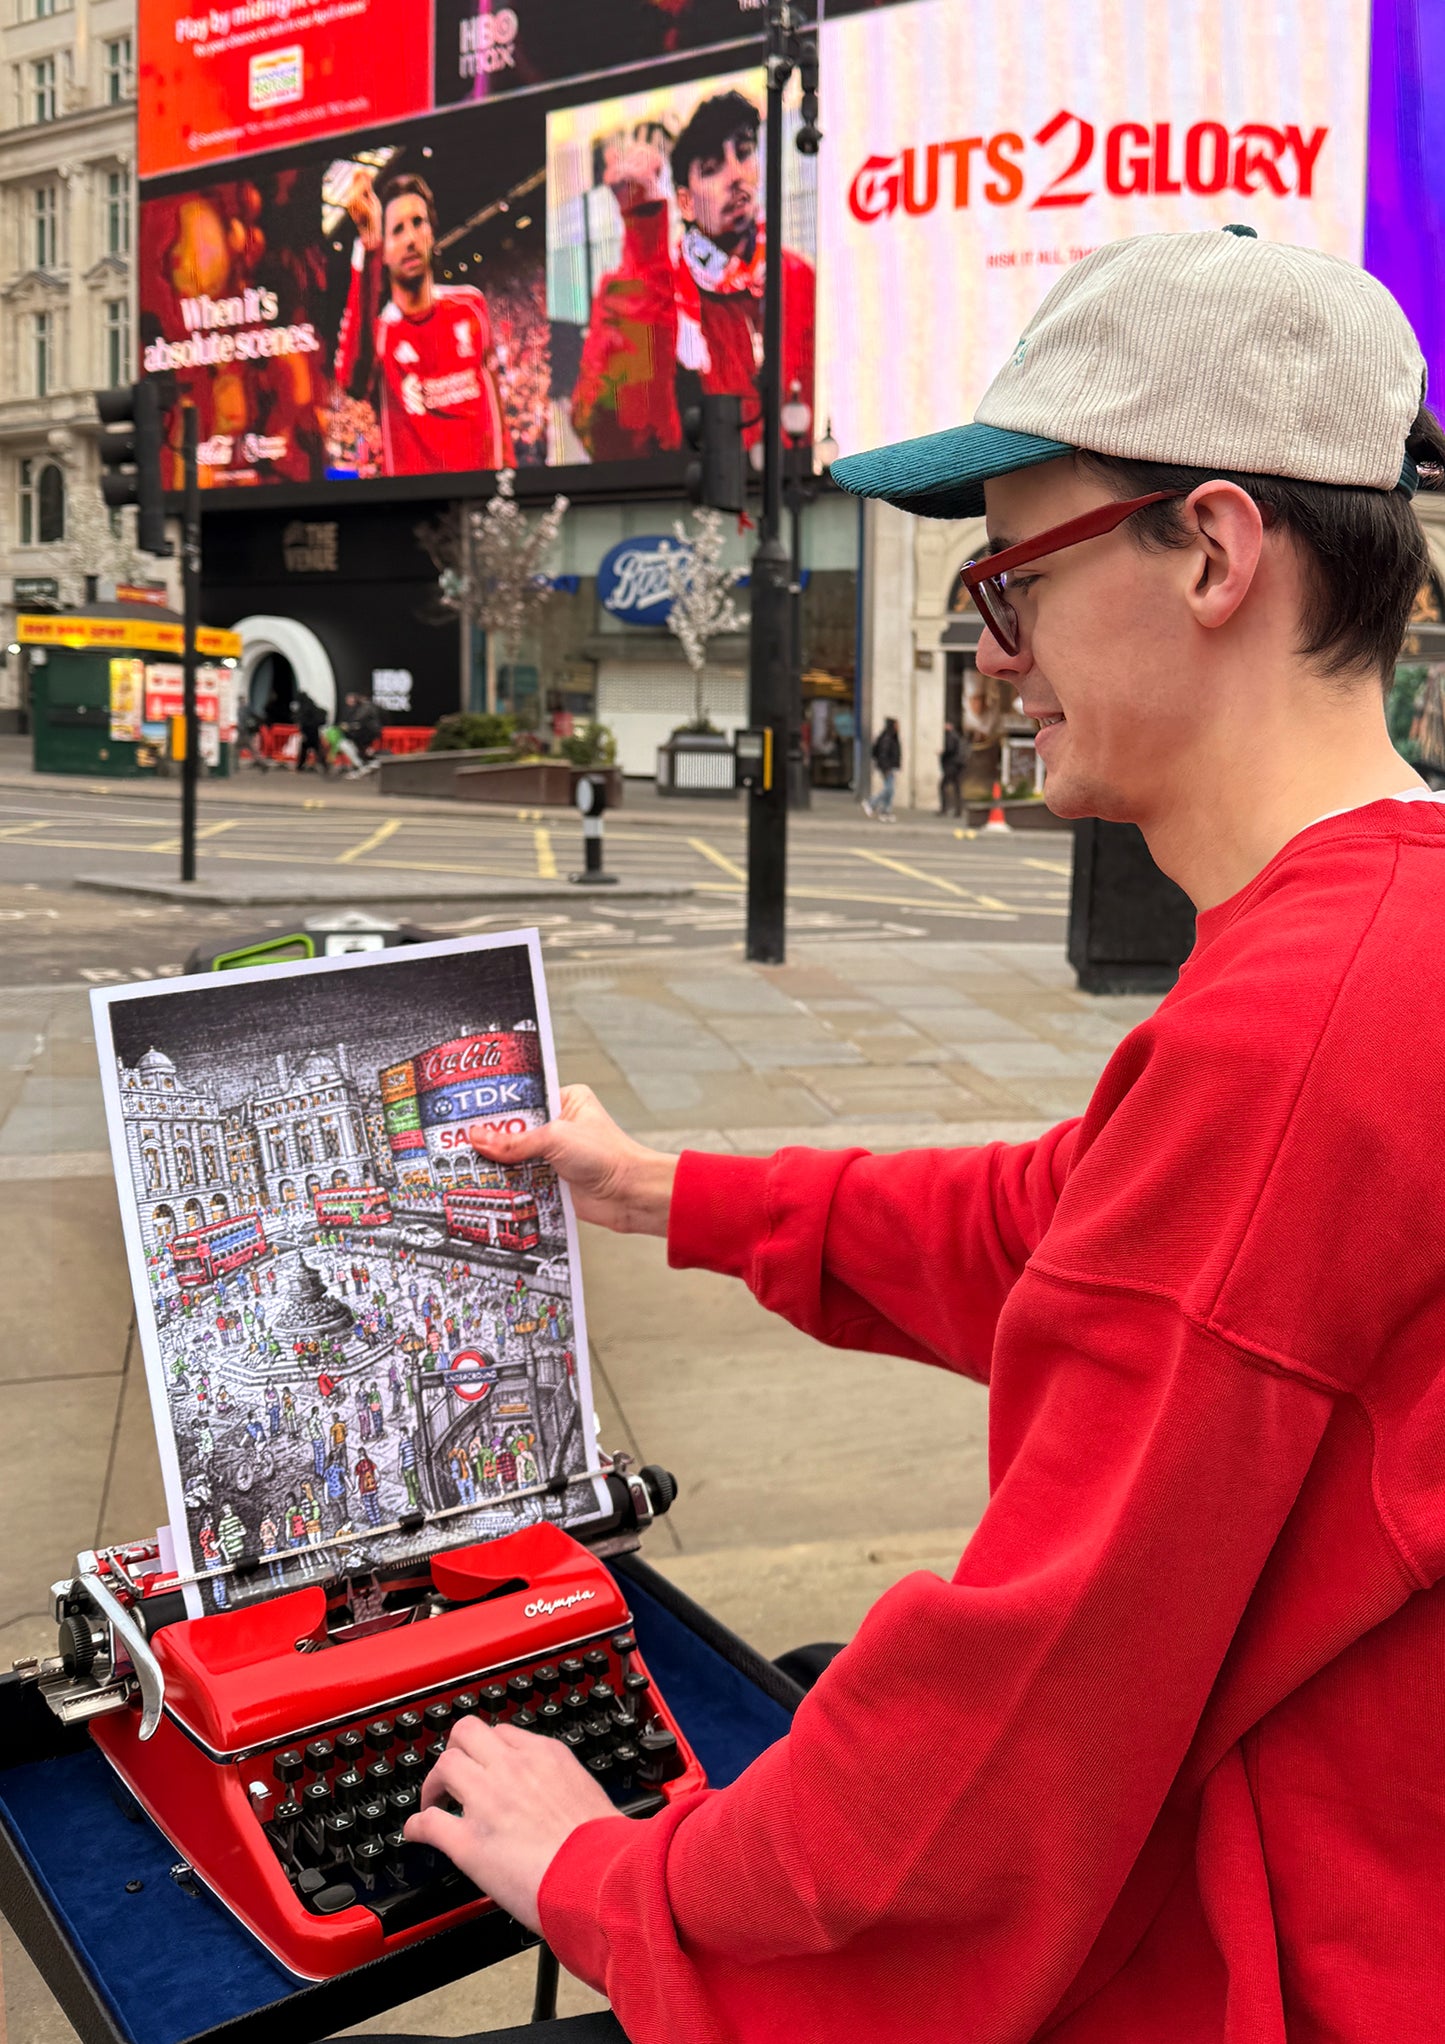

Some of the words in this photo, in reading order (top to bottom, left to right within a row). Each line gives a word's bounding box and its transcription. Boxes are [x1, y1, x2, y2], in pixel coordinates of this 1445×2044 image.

[175, 16, 208, 43] Play
[460, 8, 518, 51] HBO
[144, 331, 235, 372] absolute
[452, 1083, 522, 1111] TDK
[440, 1118, 526, 1149] SAYO
[524, 1590, 596, 1617] Olympia
[312, 1785, 327, 1794] Q
[341, 1773, 357, 1784] W
[374, 1763, 388, 1773] E
[404, 1753, 418, 1763] R
[336, 1819, 348, 1828] A
[366, 1806, 379, 1815] S
[396, 1794, 410, 1804] D
[363, 1843, 378, 1854] Z
